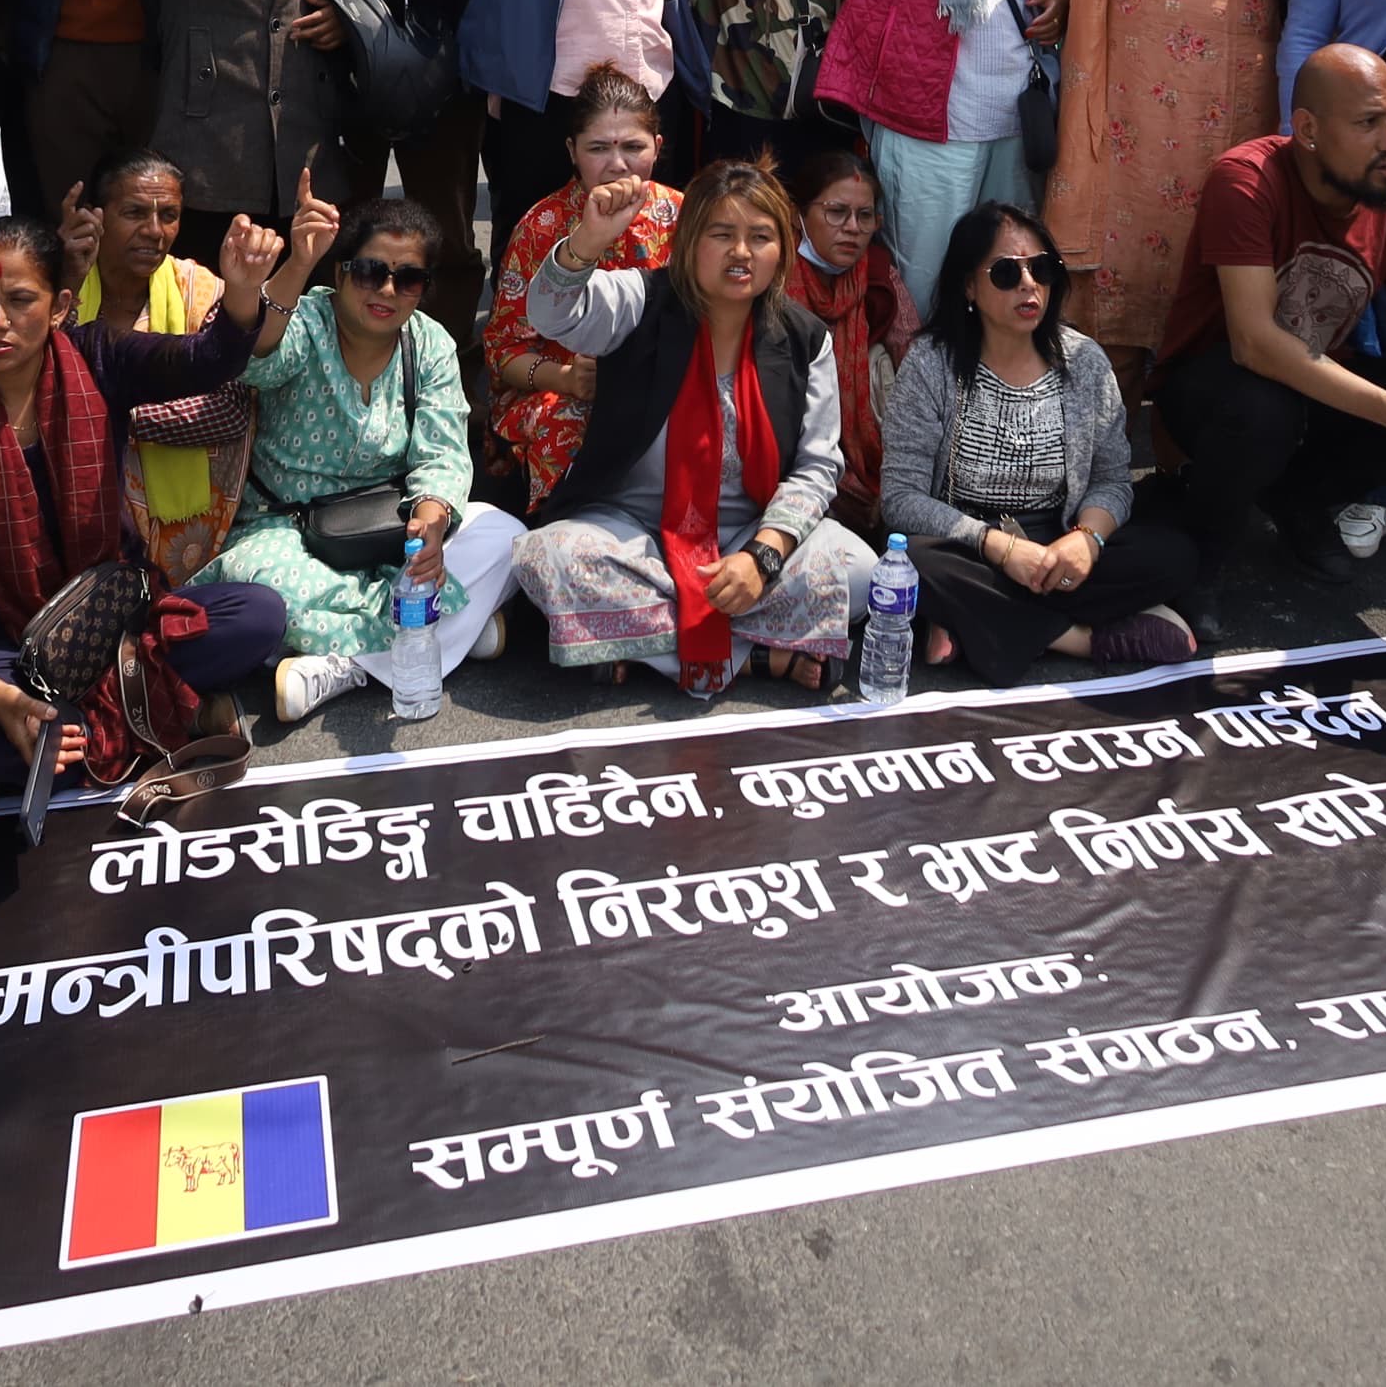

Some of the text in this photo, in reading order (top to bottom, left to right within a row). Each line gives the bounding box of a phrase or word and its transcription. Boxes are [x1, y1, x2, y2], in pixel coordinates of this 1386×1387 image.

[89, 798, 435, 894] लोडसेडिङ्ग
[731, 741, 995, 820] कुलमान
[992, 718, 1206, 782] हटाउन
[556, 859, 837, 946] निरंकुश
[838, 847, 928, 908] र
[908, 830, 1060, 904] भ्रष्ट
[1048, 798, 1274, 876] निर्णय
[409, 1090, 677, 1189] सम्पूर्ण
[696, 1051, 1018, 1139] संयोजित
[1025, 1009, 1297, 1084] संगठन,
